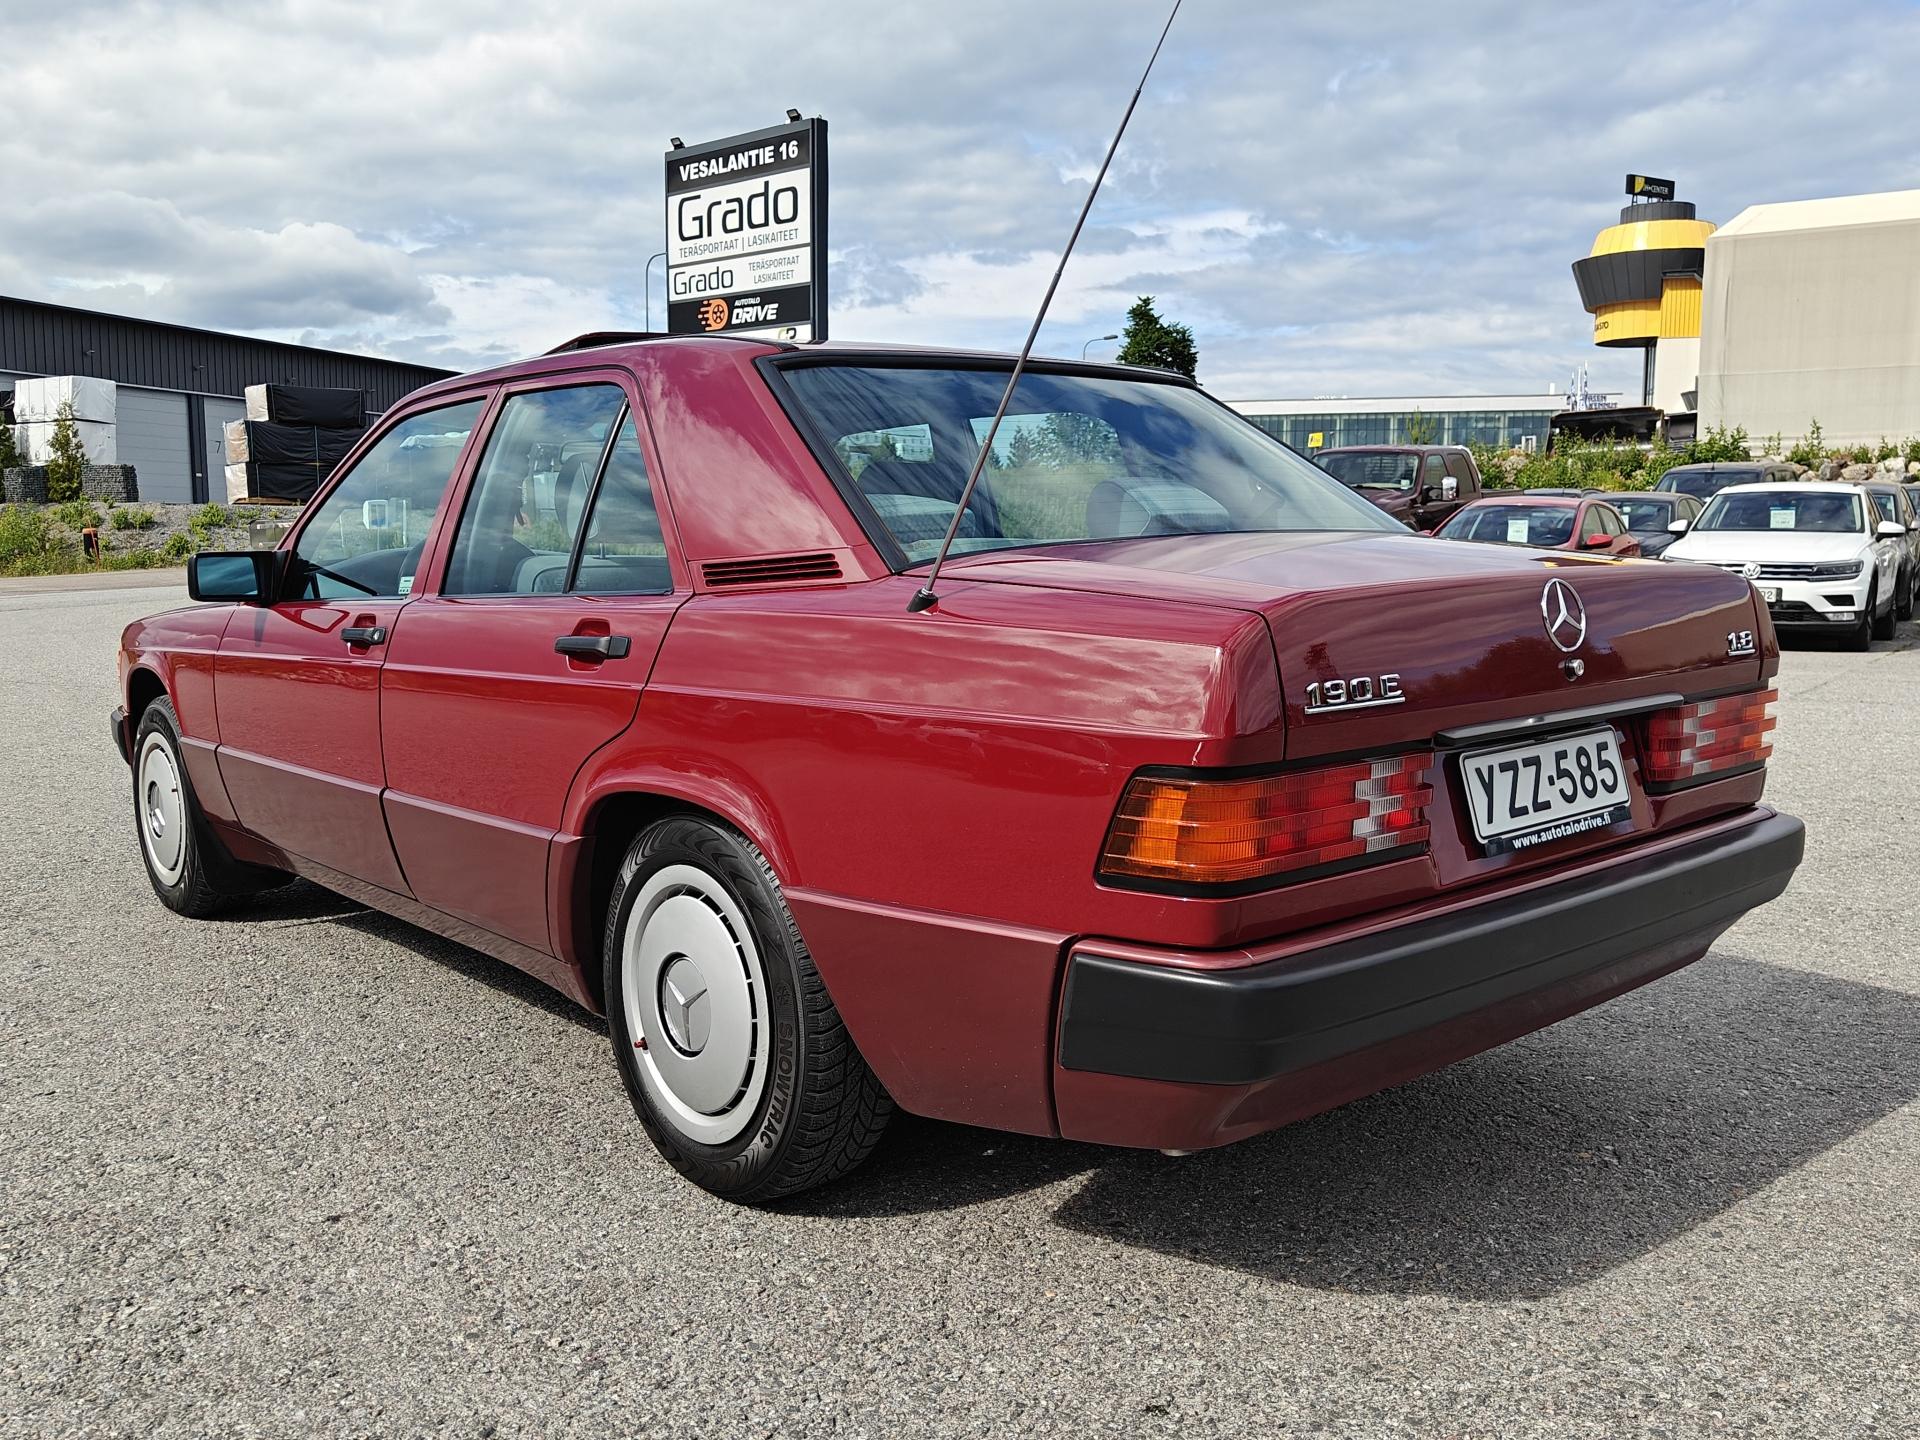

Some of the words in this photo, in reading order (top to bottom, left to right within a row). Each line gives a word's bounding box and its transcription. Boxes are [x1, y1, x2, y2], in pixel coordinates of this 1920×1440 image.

[679, 146, 775, 182] VESALANTIE
[779, 140, 799, 160] 16
[678, 180, 799, 242] Grado
[679, 237, 739, 259] TERÄSPORTAAT
[747, 228, 799, 248] LASIKAITEET
[748, 255, 800, 272] TERÄSPORTAAT
[753, 269, 795, 285] LASIKAITEET
[674, 266, 734, 296] Grado
[731, 303, 779, 325] DRIVE
[734, 296, 761, 307] AUTOTALO
[215, 440, 221, 454] 7
[1727, 630, 1753, 651] 1.8
[1305, 677, 1373, 706] 190
[1380, 674, 1402, 698] E
[1475, 741, 1618, 825] YZZ-585
[1512, 812, 1612, 849] www.autotalodrive.fi
[760, 1021, 794, 1150] SNOWTRAC
